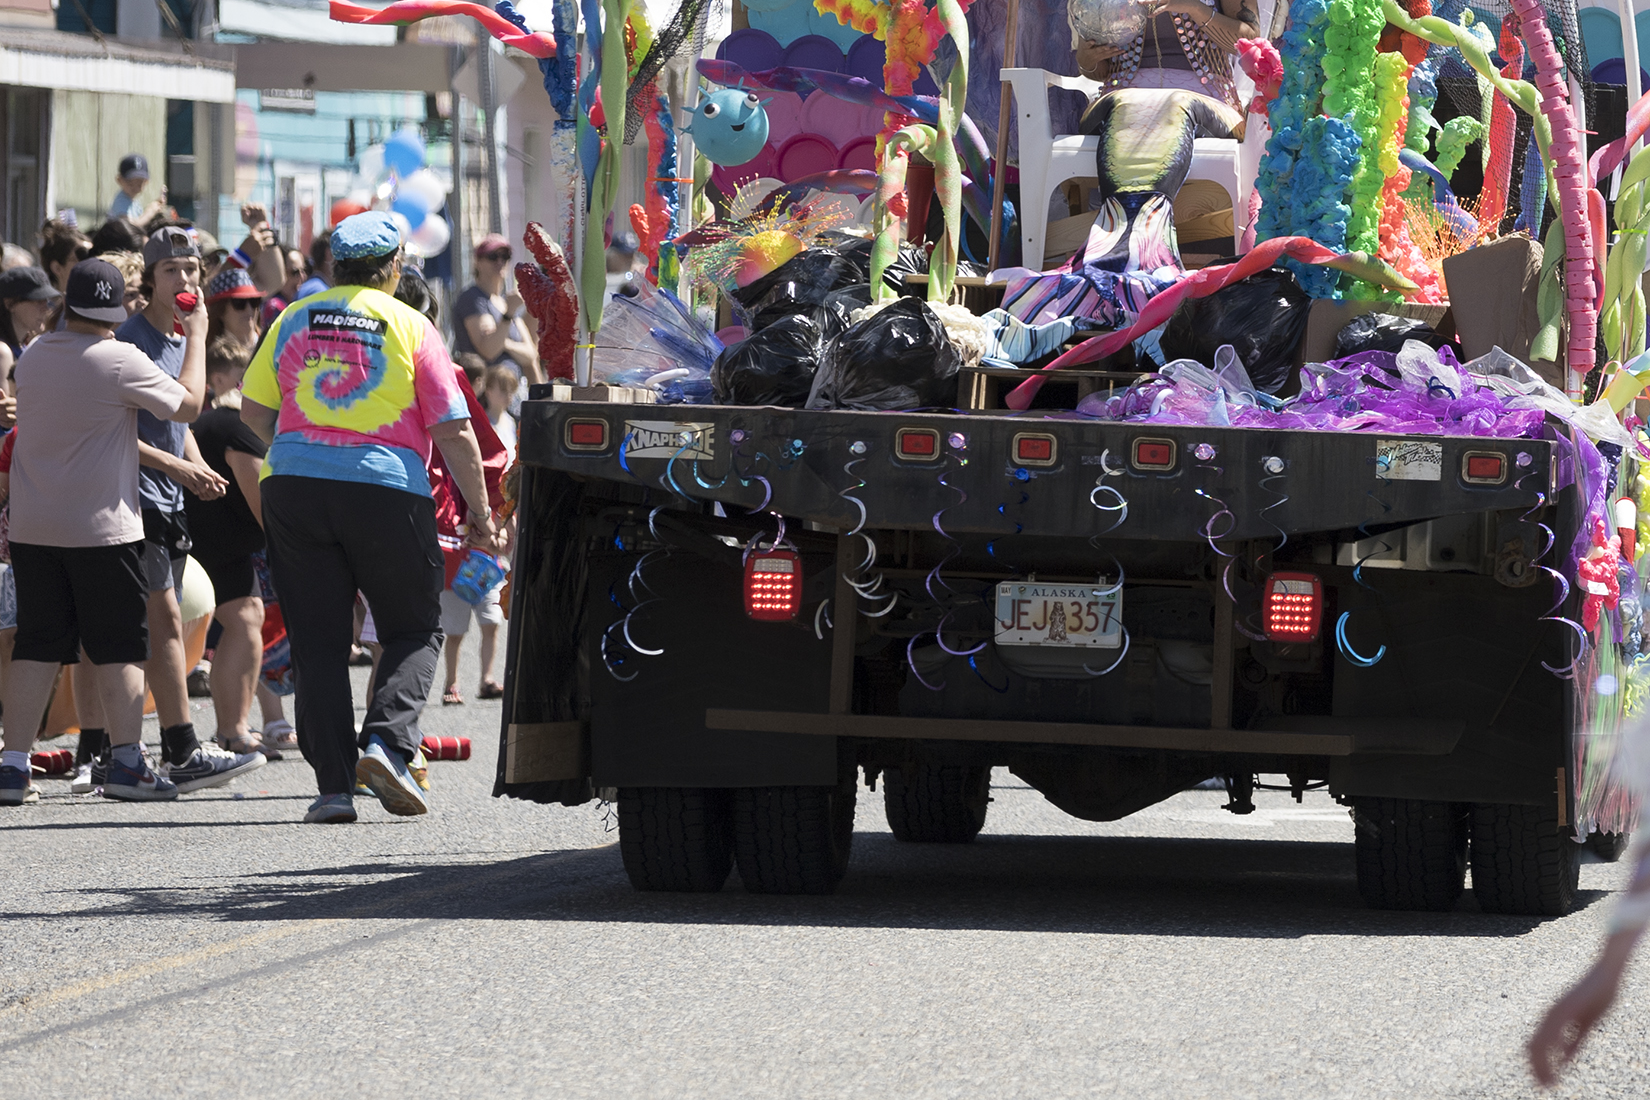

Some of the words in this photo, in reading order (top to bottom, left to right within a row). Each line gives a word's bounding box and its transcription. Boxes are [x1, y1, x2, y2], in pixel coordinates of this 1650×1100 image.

[94, 280, 112, 300] NY
[313, 314, 379, 332] MADISON
[308, 334, 335, 343] LUMBER
[341, 336, 382, 351] HARDWARE
[629, 427, 715, 456] KNAPHDE
[1001, 586, 1011, 594] MAY
[1031, 588, 1086, 598] ALASKA
[1001, 599, 1047, 631] JEJ
[1068, 601, 1116, 633] 357
